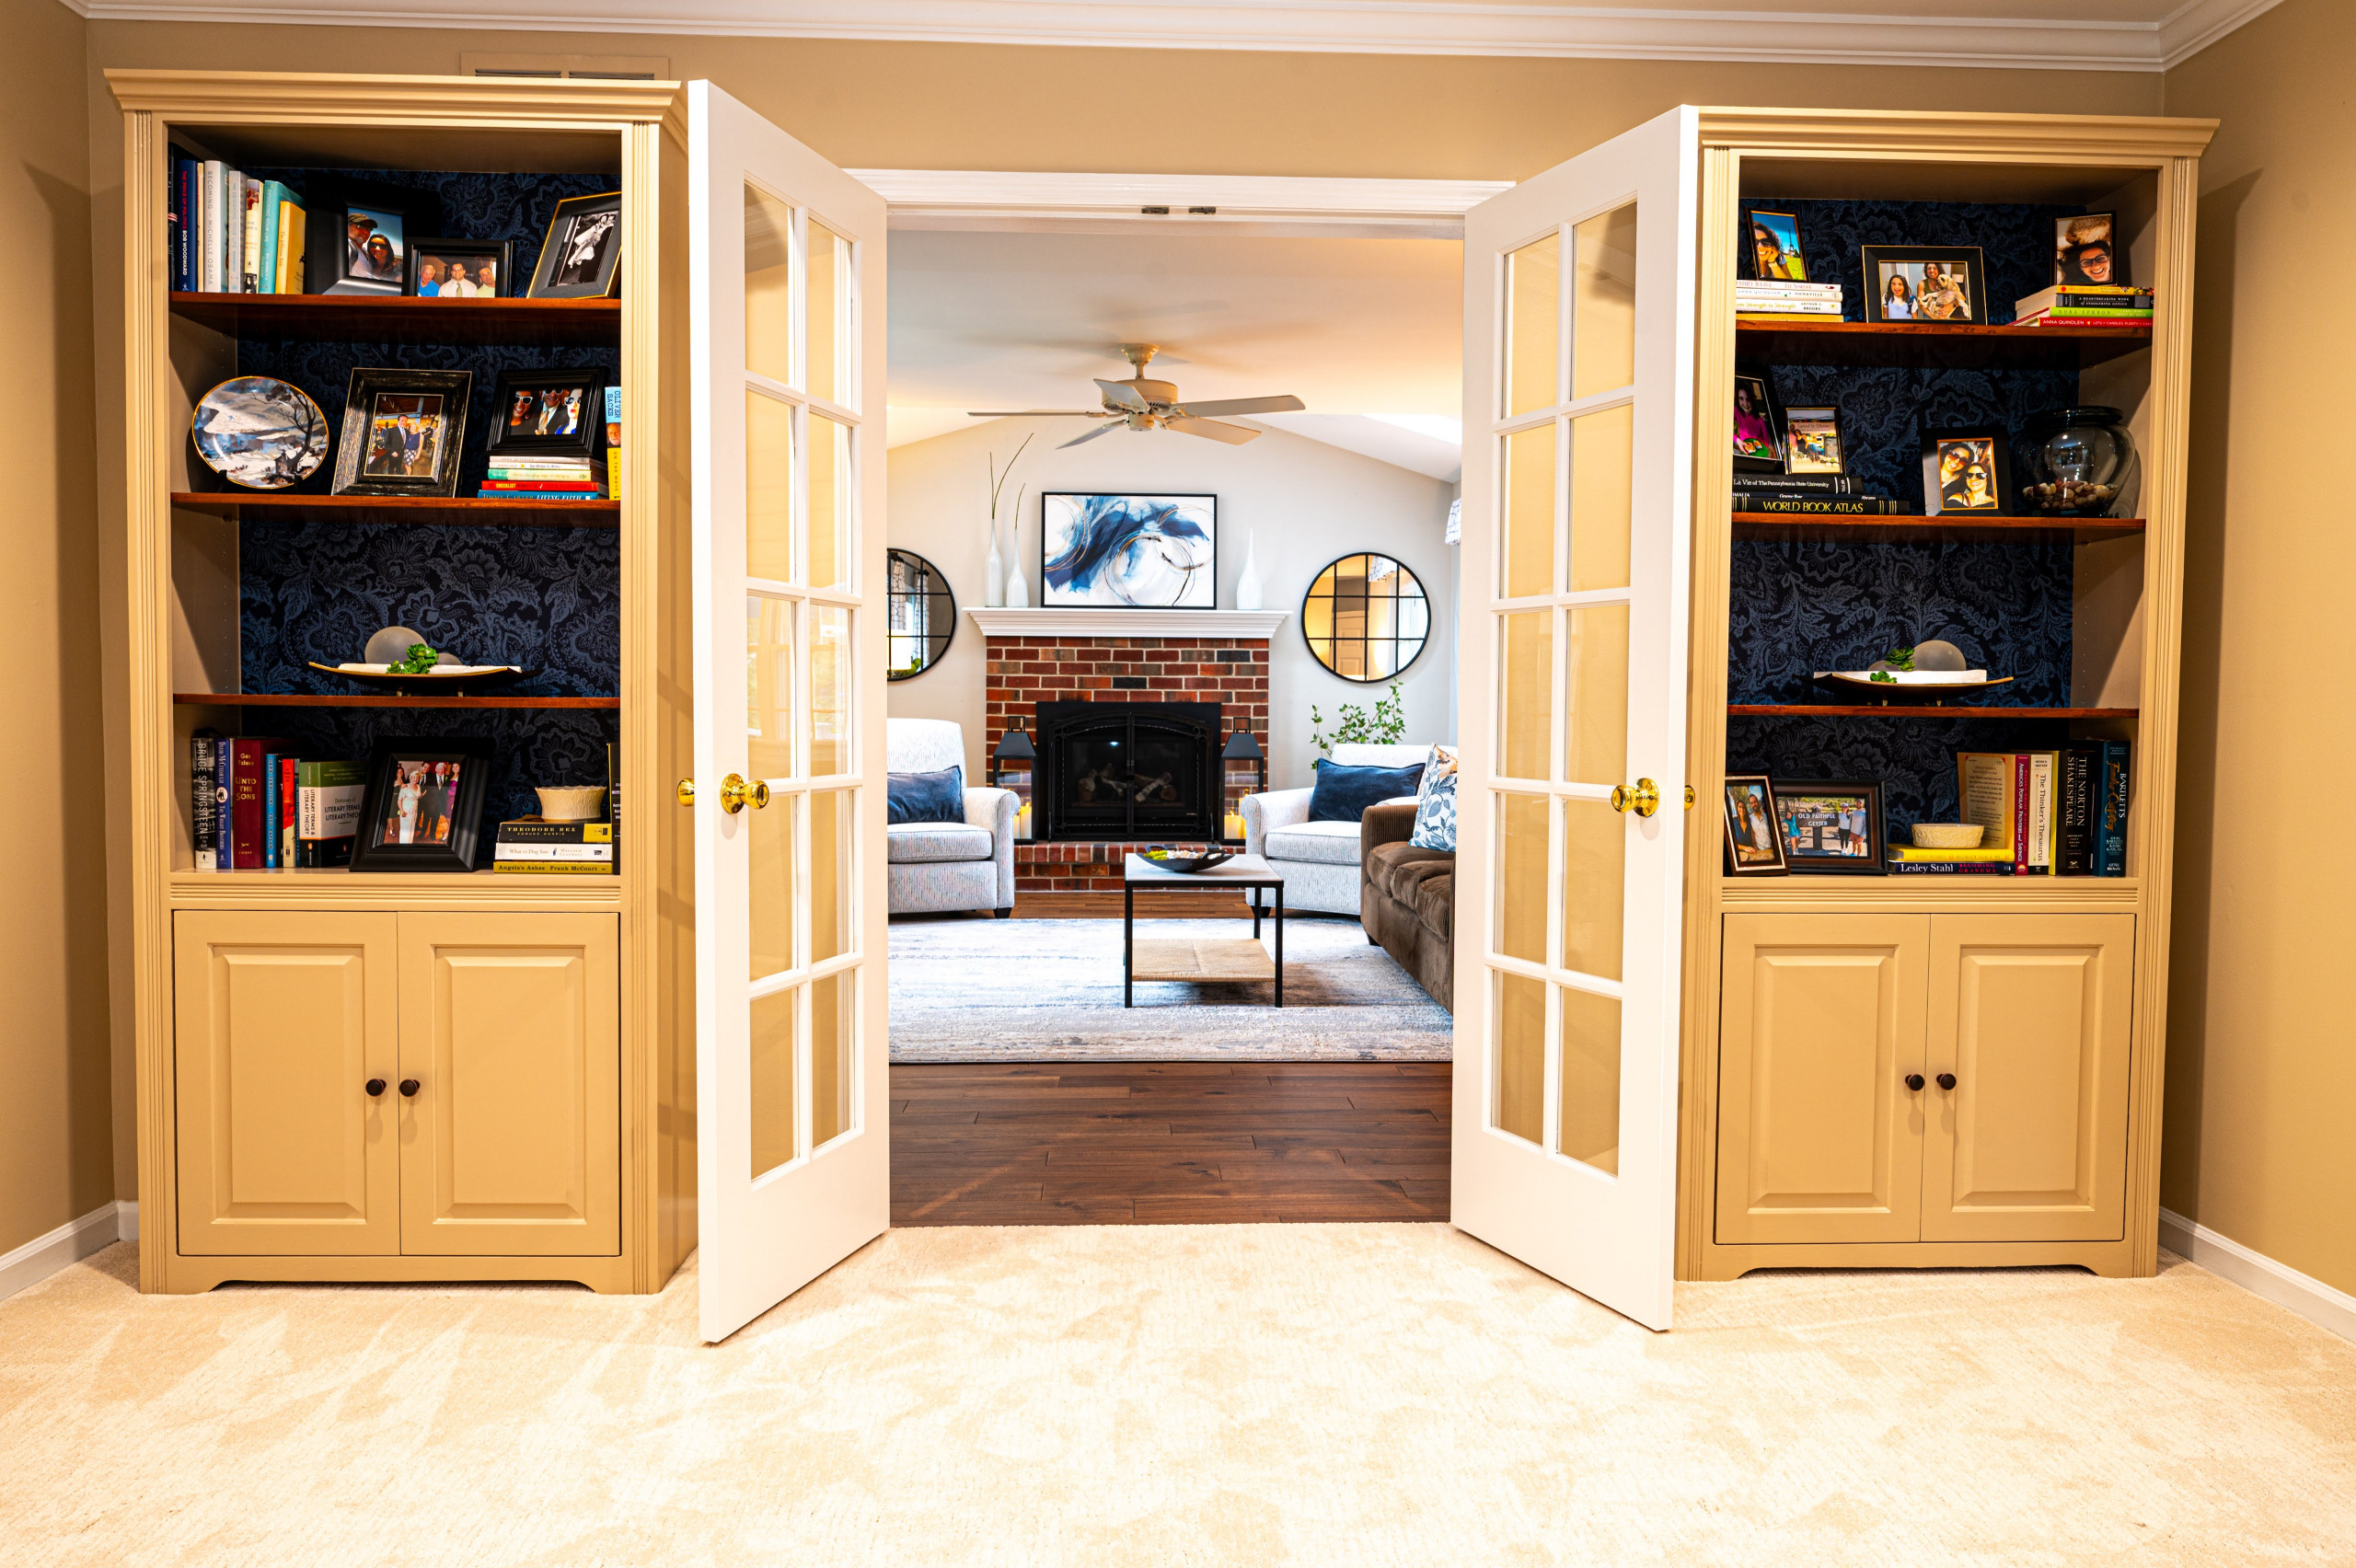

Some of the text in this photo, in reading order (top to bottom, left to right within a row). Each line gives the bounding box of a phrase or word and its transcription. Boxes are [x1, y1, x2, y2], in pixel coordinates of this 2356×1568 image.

[1763, 501, 1864, 513] WORLD BOOK ATLAS
[197, 743, 208, 833] BRUCE SPRINGSTEEN
[235, 776, 257, 785] UNTO
[2065, 756, 2075, 827] SHAKESPEARE
[2076, 757, 2087, 826] THE NORTON
[2106, 760, 2120, 793] Familiar
[236, 793, 256, 801] SONS
[2104, 792, 2119, 832] Quotations
[2118, 773, 2127, 818] BARTLETT'S
[1901, 863, 1954, 874] Lesley Stahl
